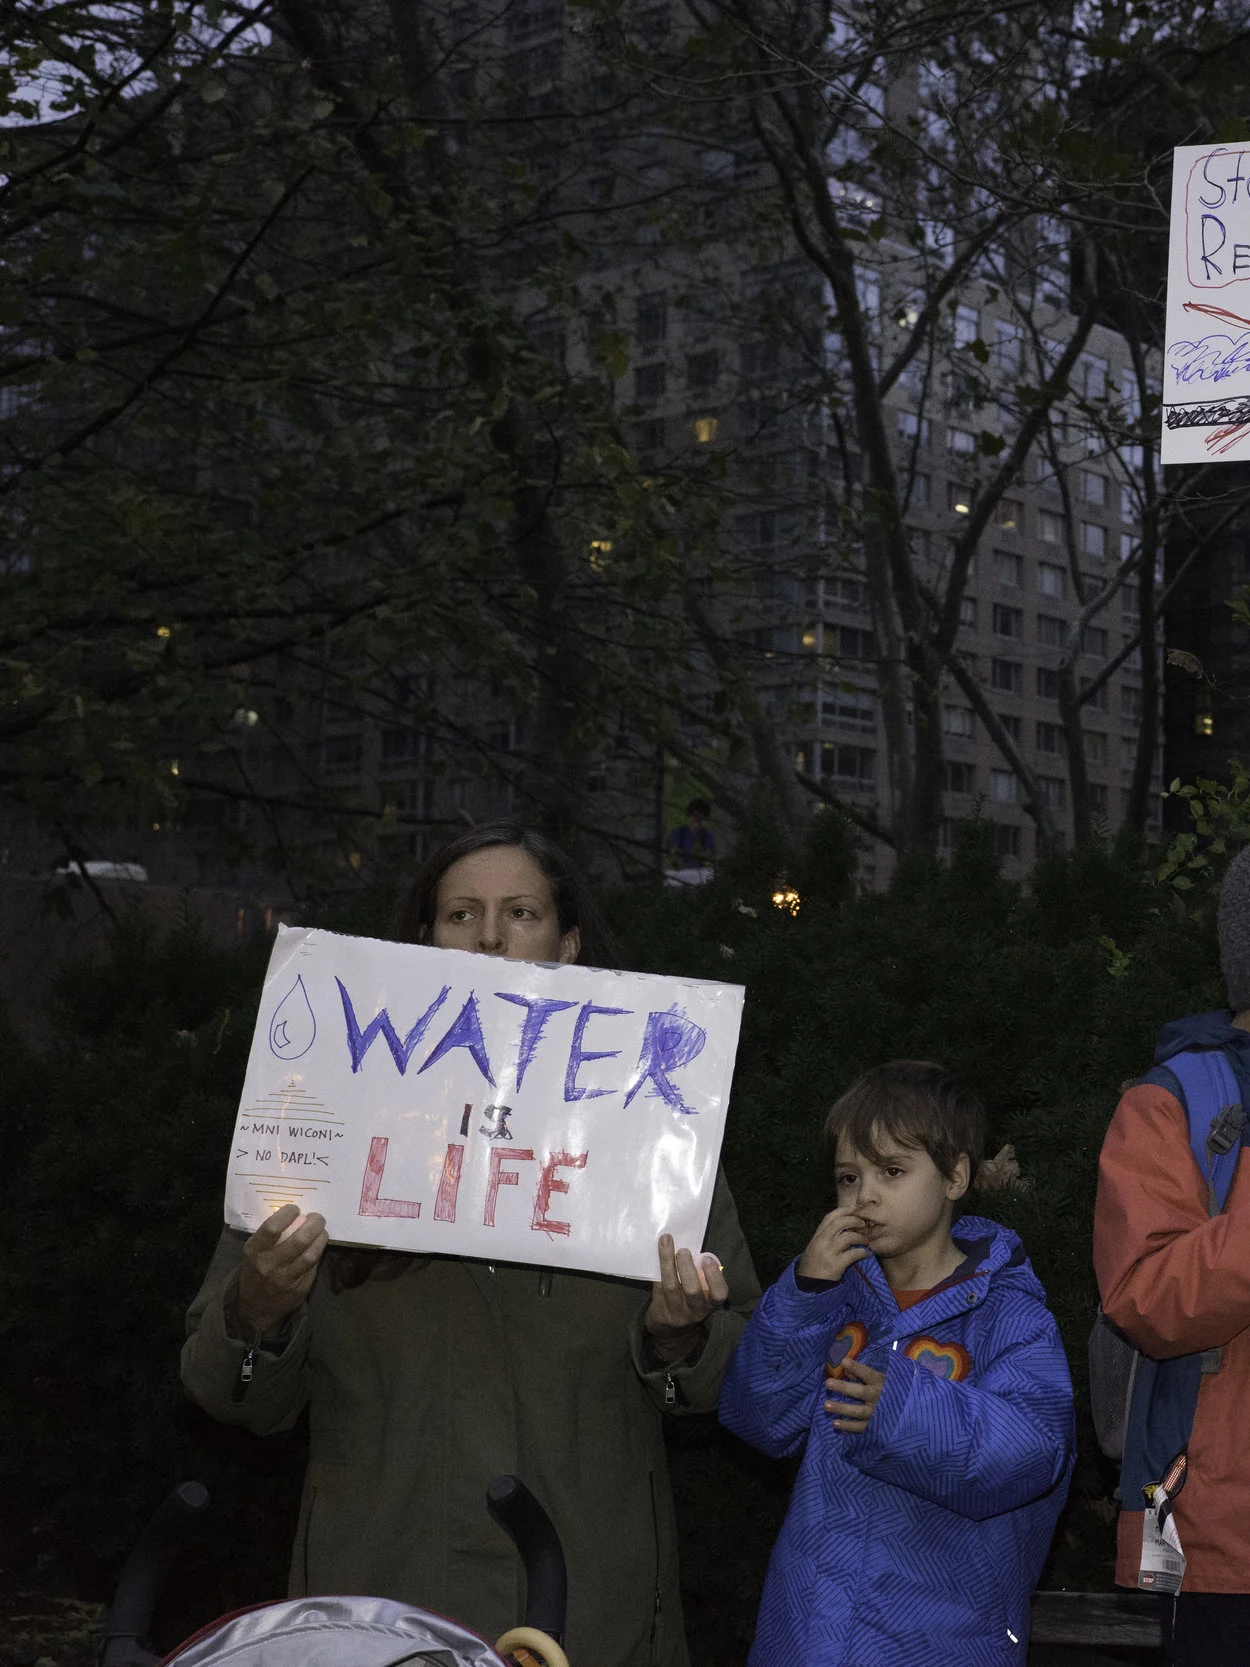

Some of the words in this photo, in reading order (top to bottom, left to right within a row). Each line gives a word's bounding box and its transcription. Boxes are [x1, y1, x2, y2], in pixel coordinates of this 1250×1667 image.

[335, 975, 706, 1116] WATER
[255, 1149, 272, 1161] NO
[459, 1102, 514, 1140] IS
[359, 1136, 588, 1240] LIFE
